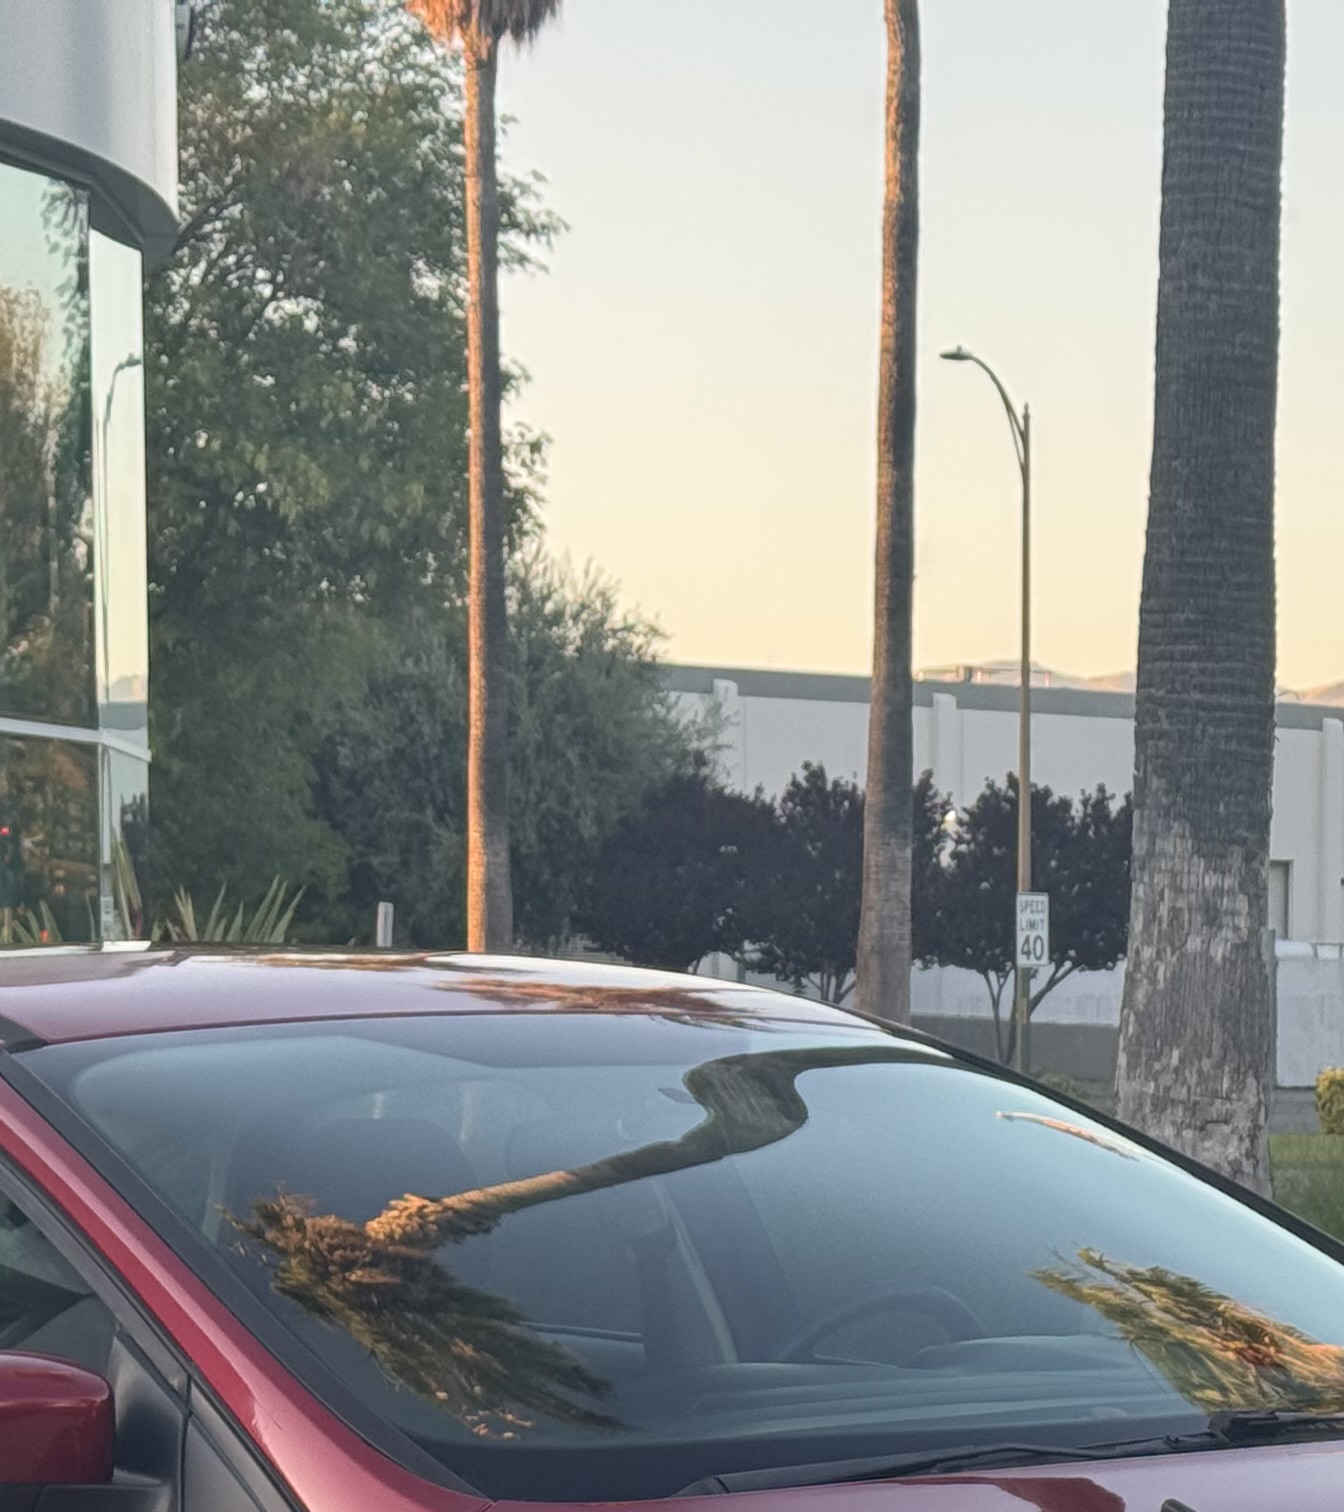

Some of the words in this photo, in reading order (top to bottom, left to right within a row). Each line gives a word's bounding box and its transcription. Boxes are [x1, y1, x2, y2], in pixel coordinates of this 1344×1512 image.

[1019, 899, 1045, 914] SPEED
[1019, 917, 1044, 931] LIMIT
[1020, 934, 1045, 961] 40
